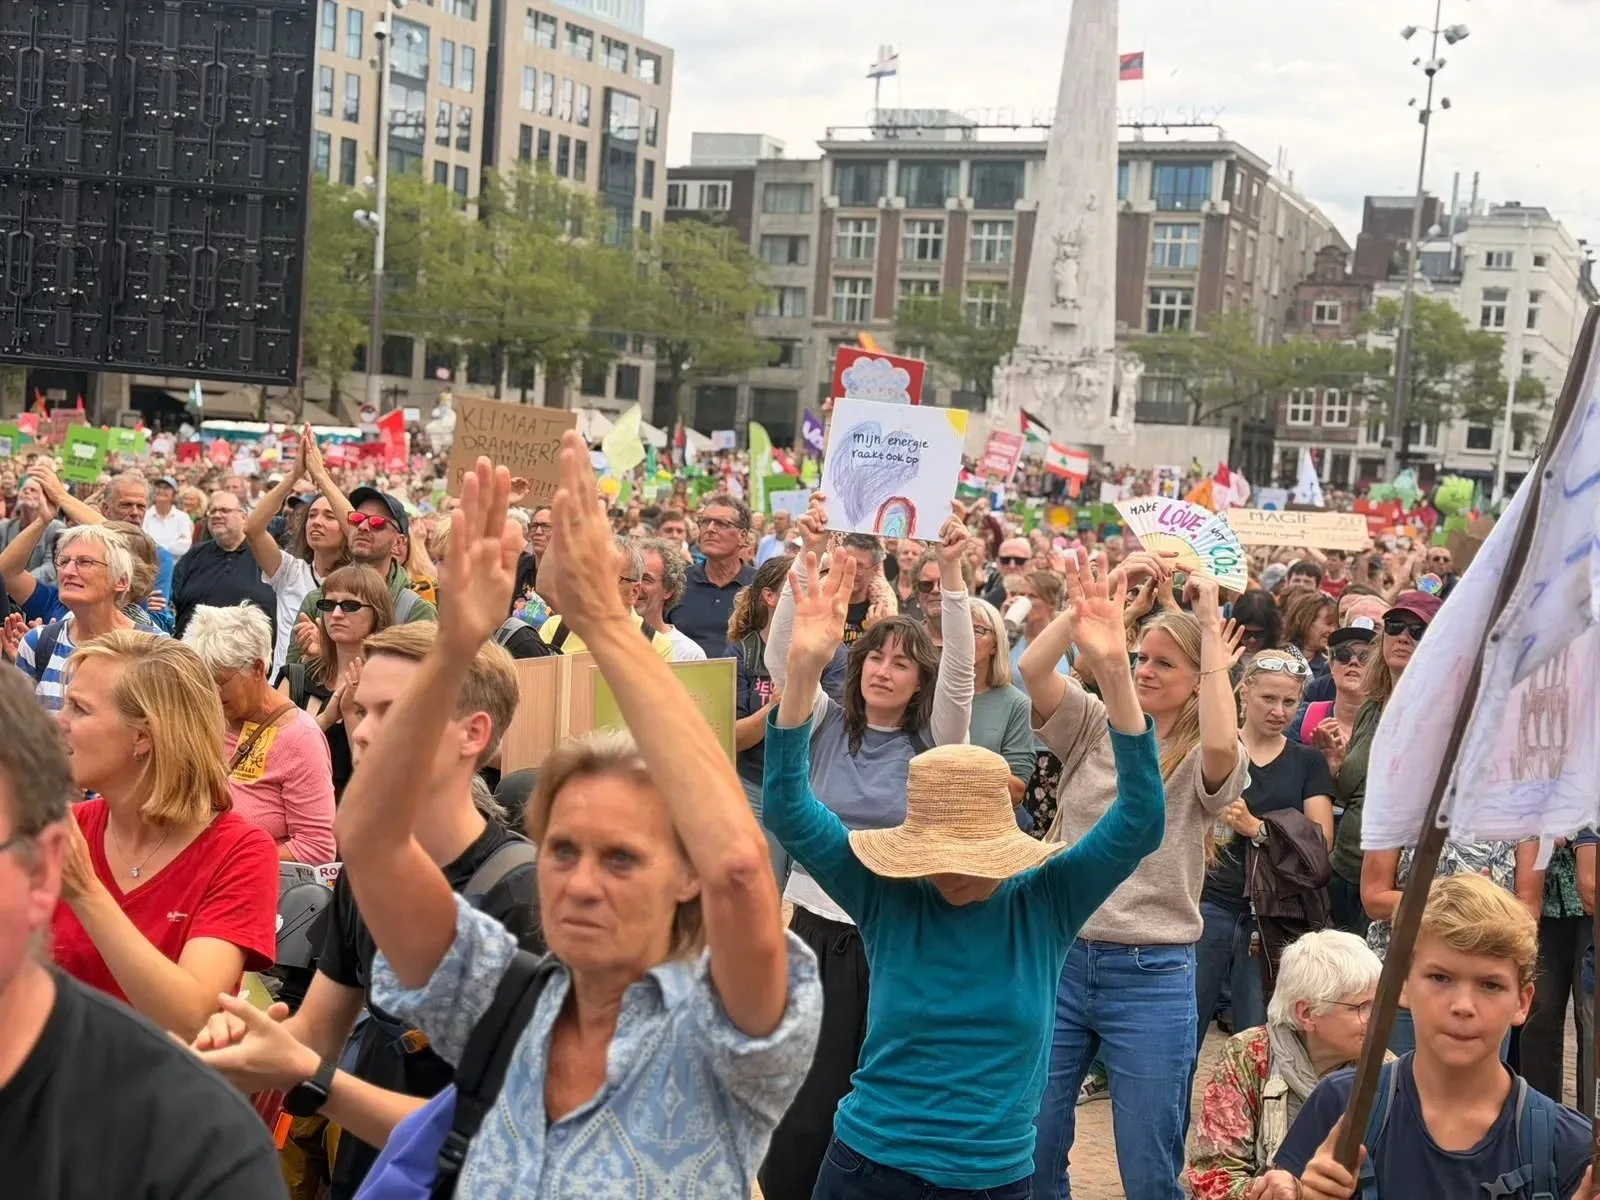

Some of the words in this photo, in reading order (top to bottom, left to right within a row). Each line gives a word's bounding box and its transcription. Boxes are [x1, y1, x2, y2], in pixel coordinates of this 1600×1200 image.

[461, 405, 564, 436] KLIMAAT
[461, 435, 561, 464] DRAMMER?
[853, 432, 880, 448] mijn
[887, 437, 929, 453] energie
[852, 449, 884, 460] raakt
[885, 453, 904, 462] ook
[905, 456, 920, 467] op
[1130, 502, 1158, 515] MAKE
[1158, 504, 1206, 532] LOVE
[1248, 511, 1313, 524] MAGIE
